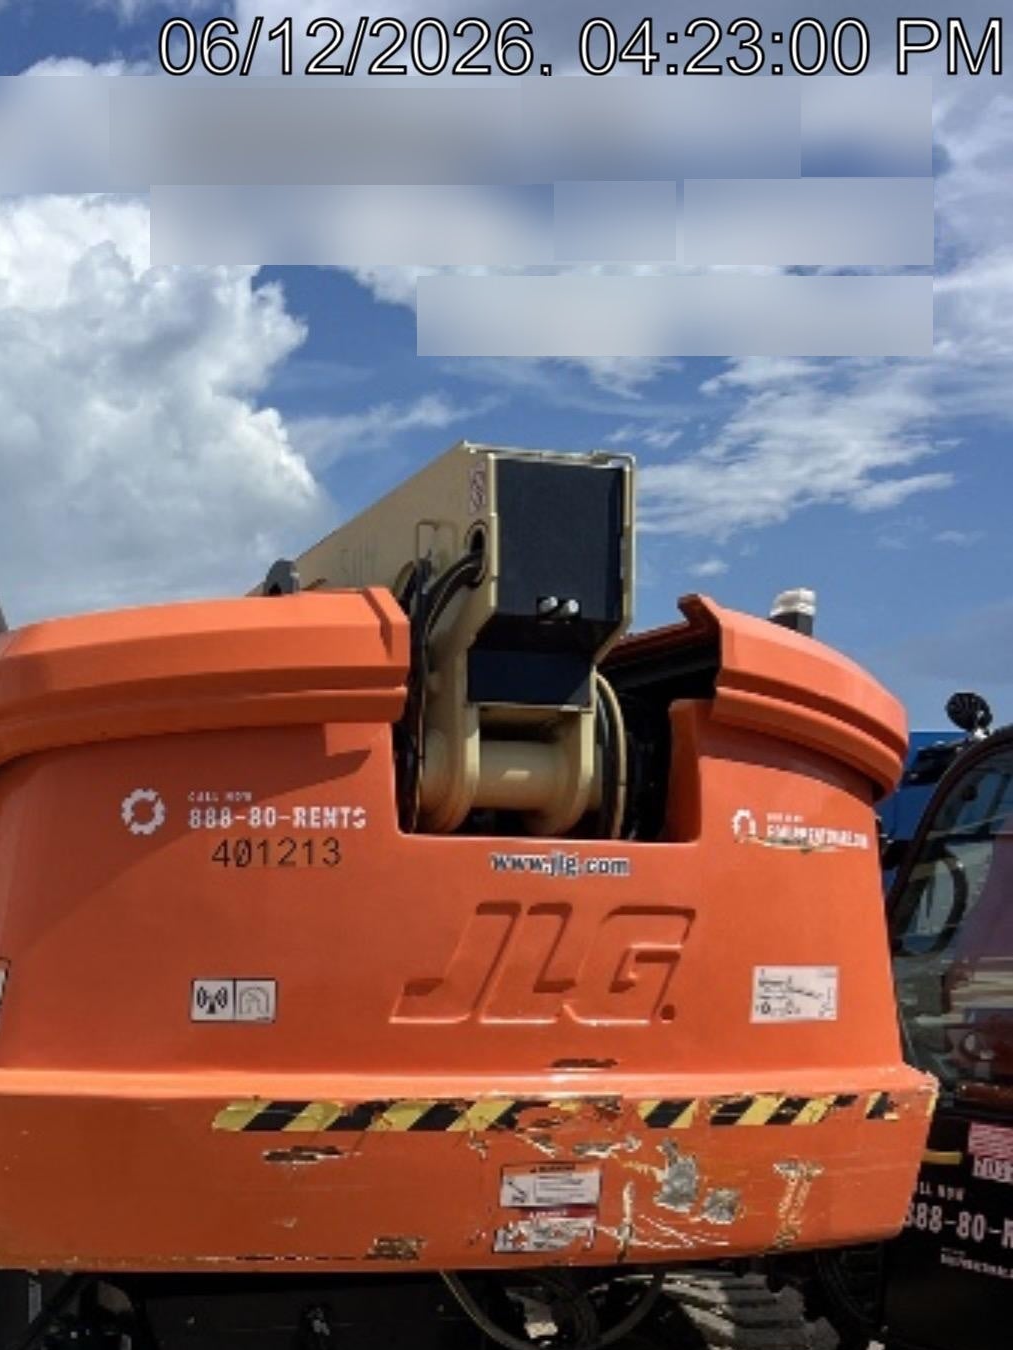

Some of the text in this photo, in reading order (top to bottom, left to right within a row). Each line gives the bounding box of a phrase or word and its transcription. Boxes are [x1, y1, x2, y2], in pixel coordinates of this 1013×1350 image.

[189, 806, 367, 829] 888-80-RENTS
[211, 836, 342, 868] 401213
[491, 852, 630, 877] www.jlg.com
[388, 900, 697, 1026] JLG
